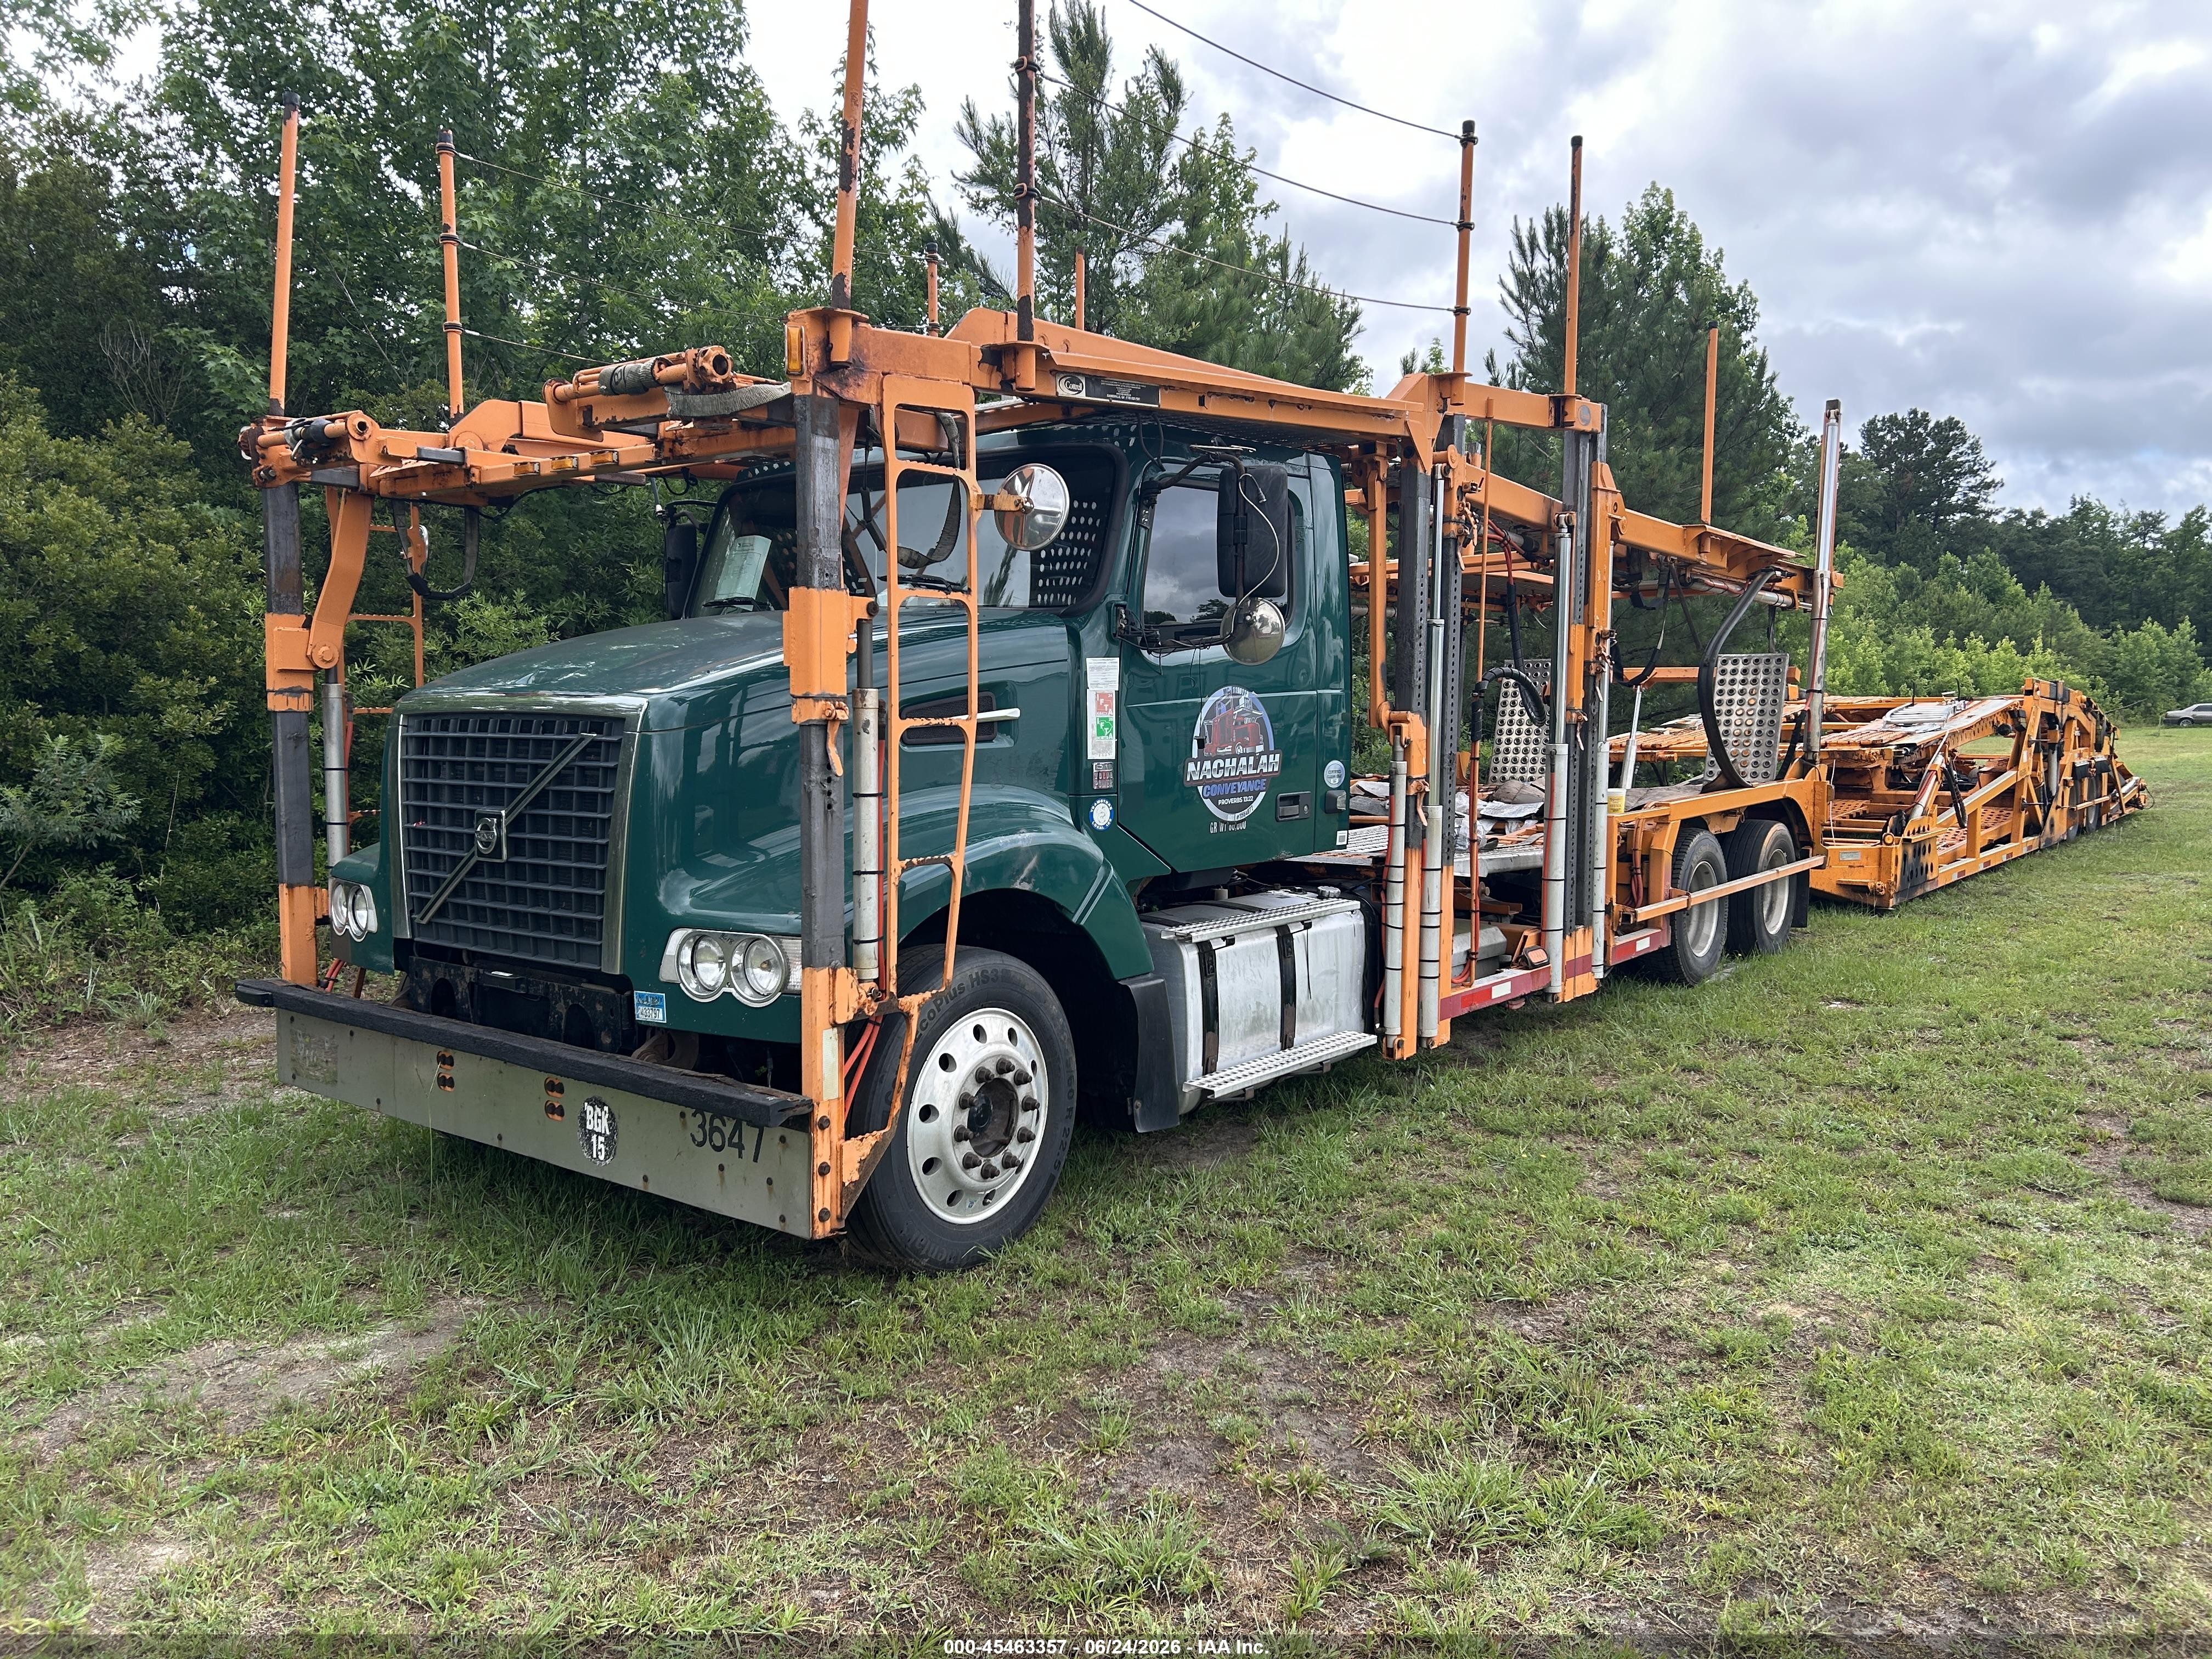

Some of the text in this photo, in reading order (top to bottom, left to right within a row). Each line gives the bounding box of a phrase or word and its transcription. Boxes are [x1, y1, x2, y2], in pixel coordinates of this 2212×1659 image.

[1065, 380, 1082, 391] Cottrell
[1187, 753, 1280, 781] NACHALAH
[1203, 778, 1267, 797] CONVEYANCE
[1218, 796, 1243, 805] PROVERBS
[968, 968, 999, 989] HS3
[690, 1109, 764, 1163] 3647
[591, 1133, 605, 1161] 15
